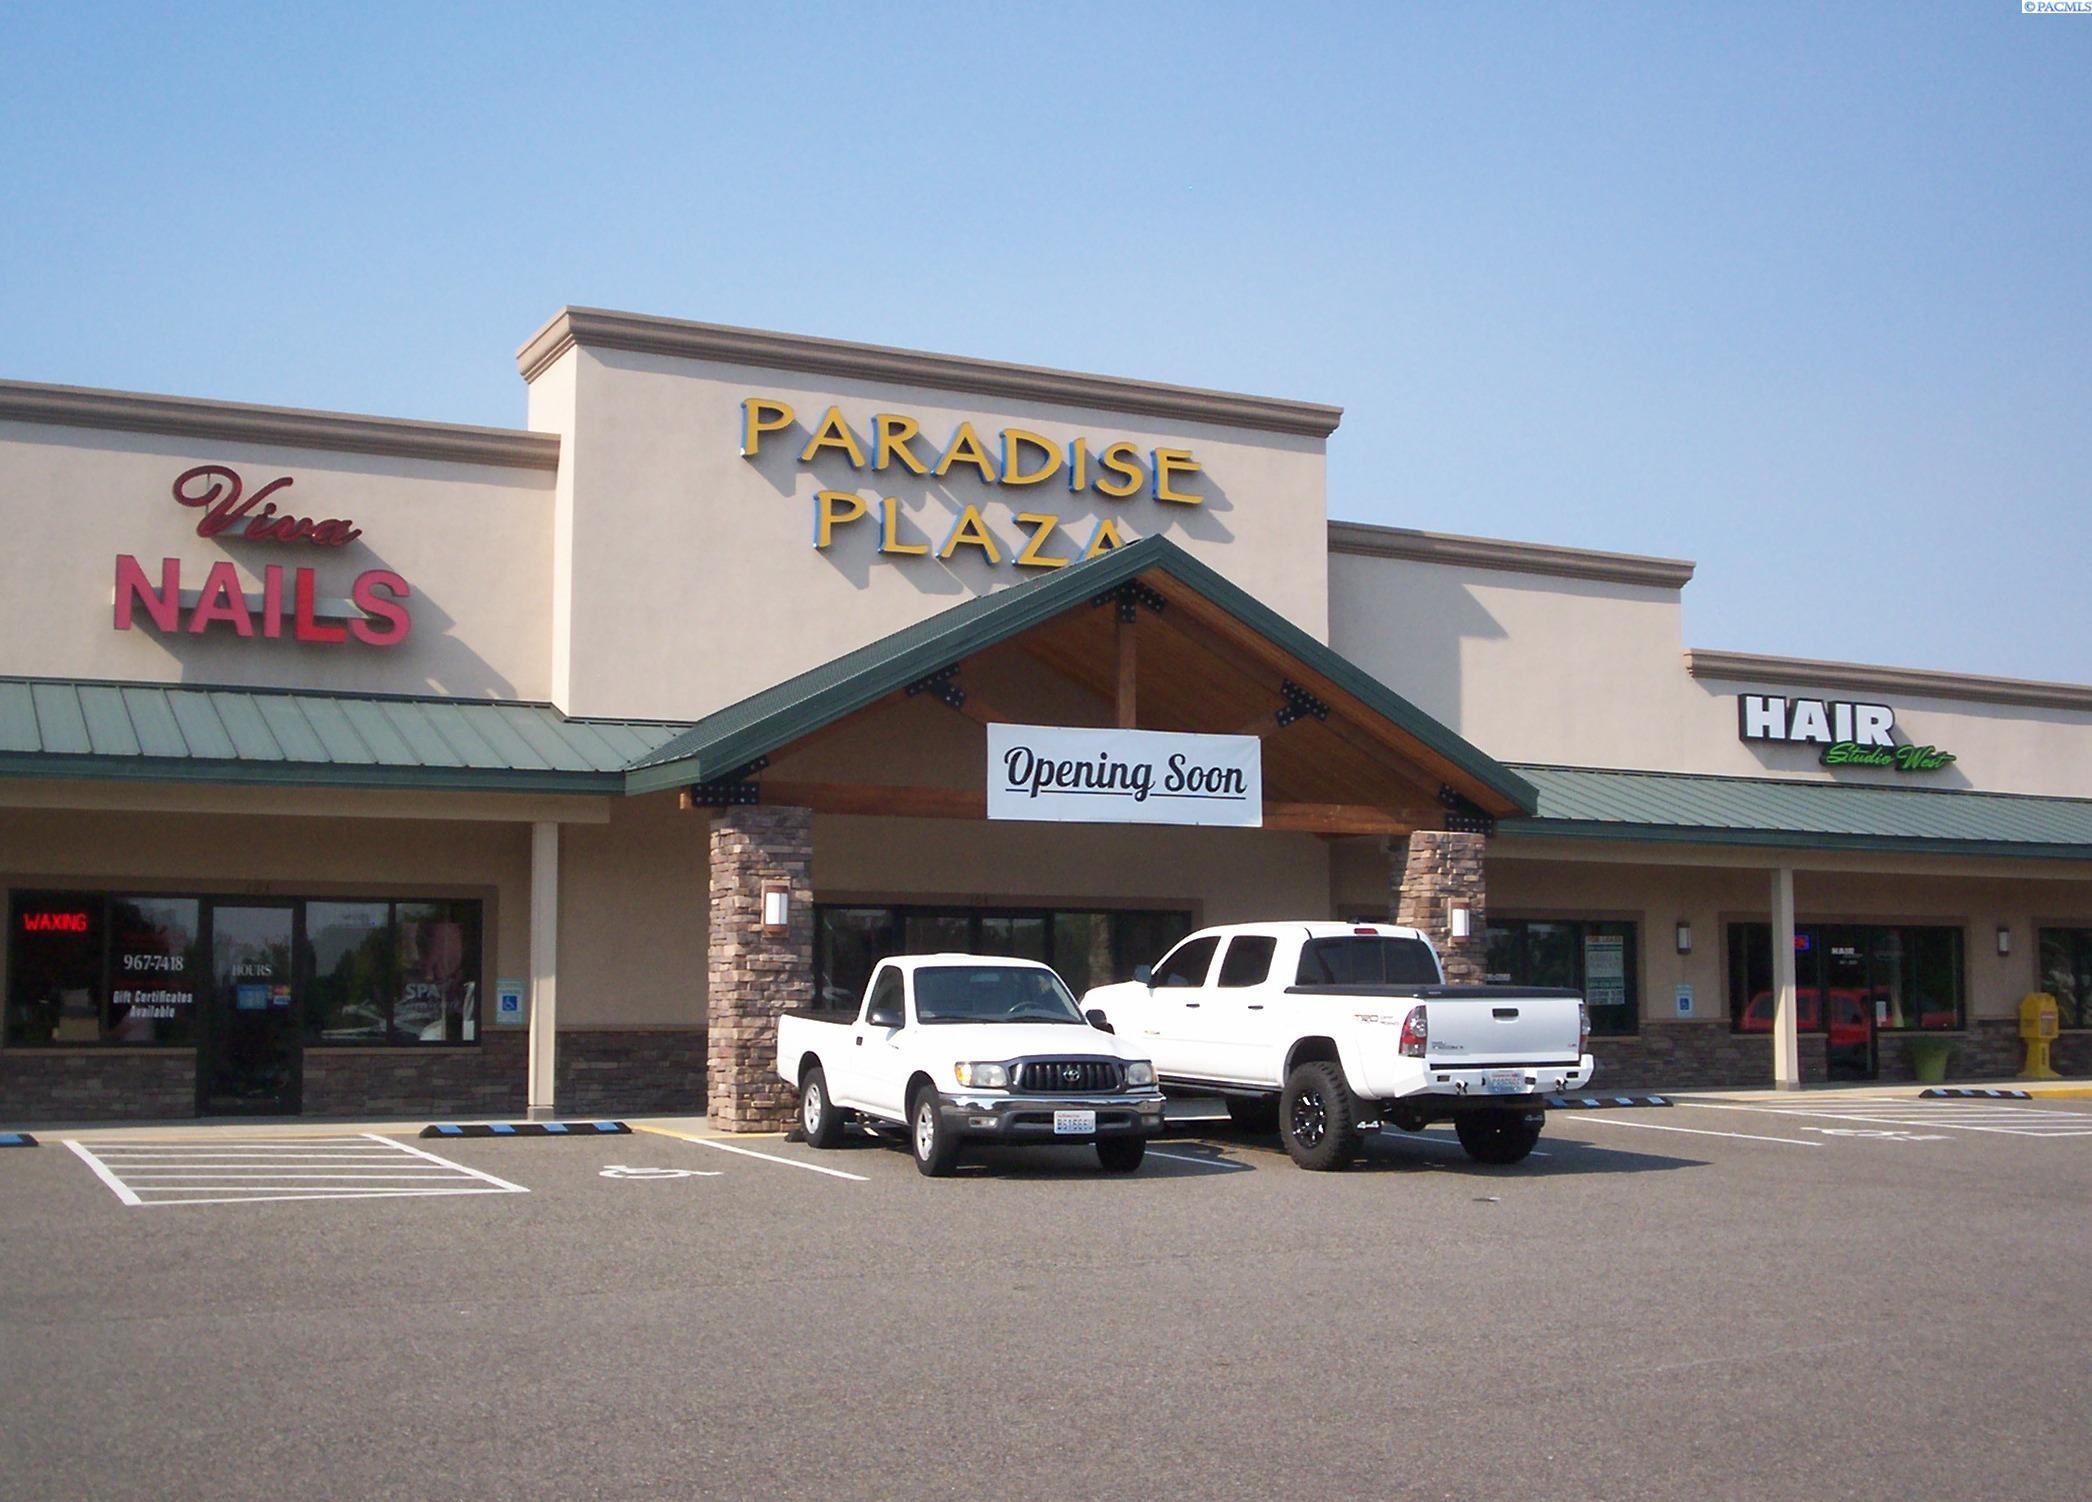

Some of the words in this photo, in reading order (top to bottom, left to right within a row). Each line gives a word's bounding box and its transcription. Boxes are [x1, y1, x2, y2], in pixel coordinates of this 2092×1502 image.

[740, 397, 1204, 504] PARADISE
[172, 464, 363, 546] Viva
[113, 554, 412, 646] NAILS
[1740, 694, 1895, 747] HAIR
[1004, 746, 1155, 801] Opening
[1164, 753, 1247, 793] Soon
[1822, 740, 1894, 769] Studio
[1896, 743, 1957, 770] West
[22, 912, 88, 932] WAXING
[123, 954, 184, 971] 967-7418
[232, 964, 272, 976] HOURS
[405, 983, 440, 1000] SPA
